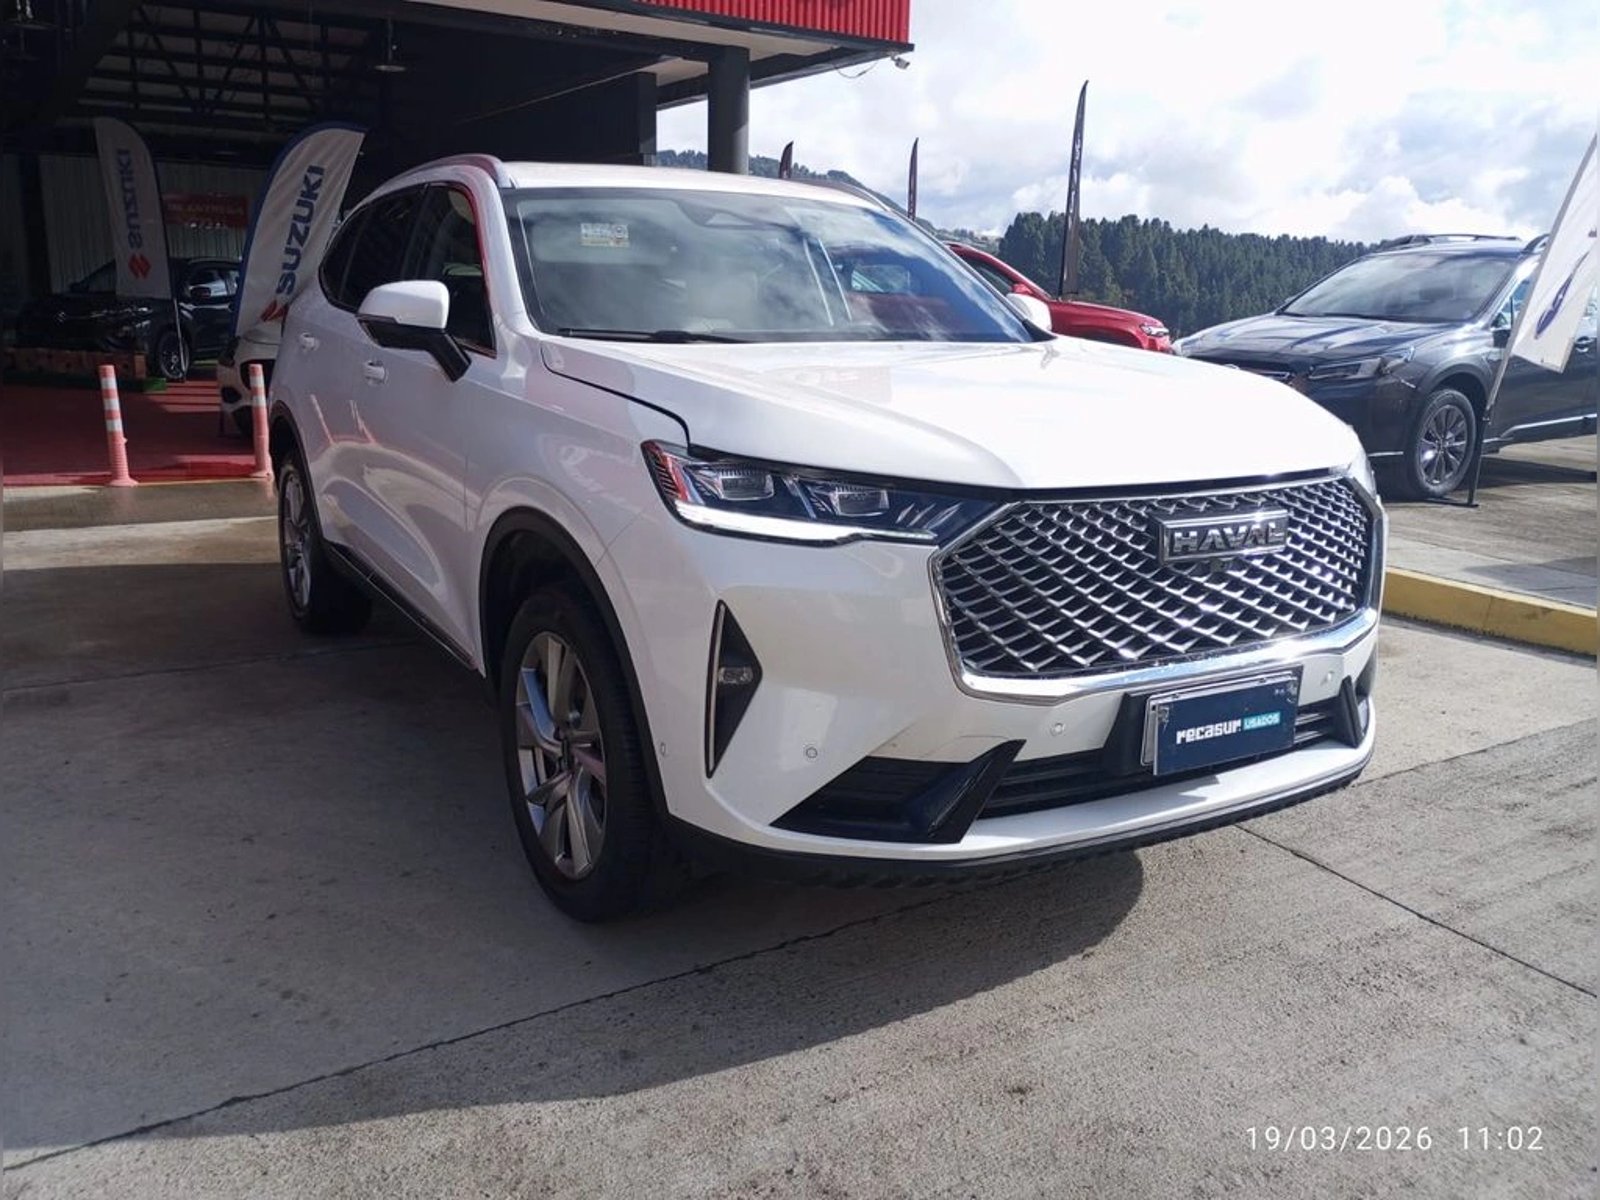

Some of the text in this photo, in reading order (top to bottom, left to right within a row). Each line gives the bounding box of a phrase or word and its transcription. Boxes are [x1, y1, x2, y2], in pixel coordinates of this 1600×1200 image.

[276, 164, 325, 295] SUZUKI
[1173, 521, 1285, 552] HAVAL
[1176, 711, 1281, 745] recasur USADOS
